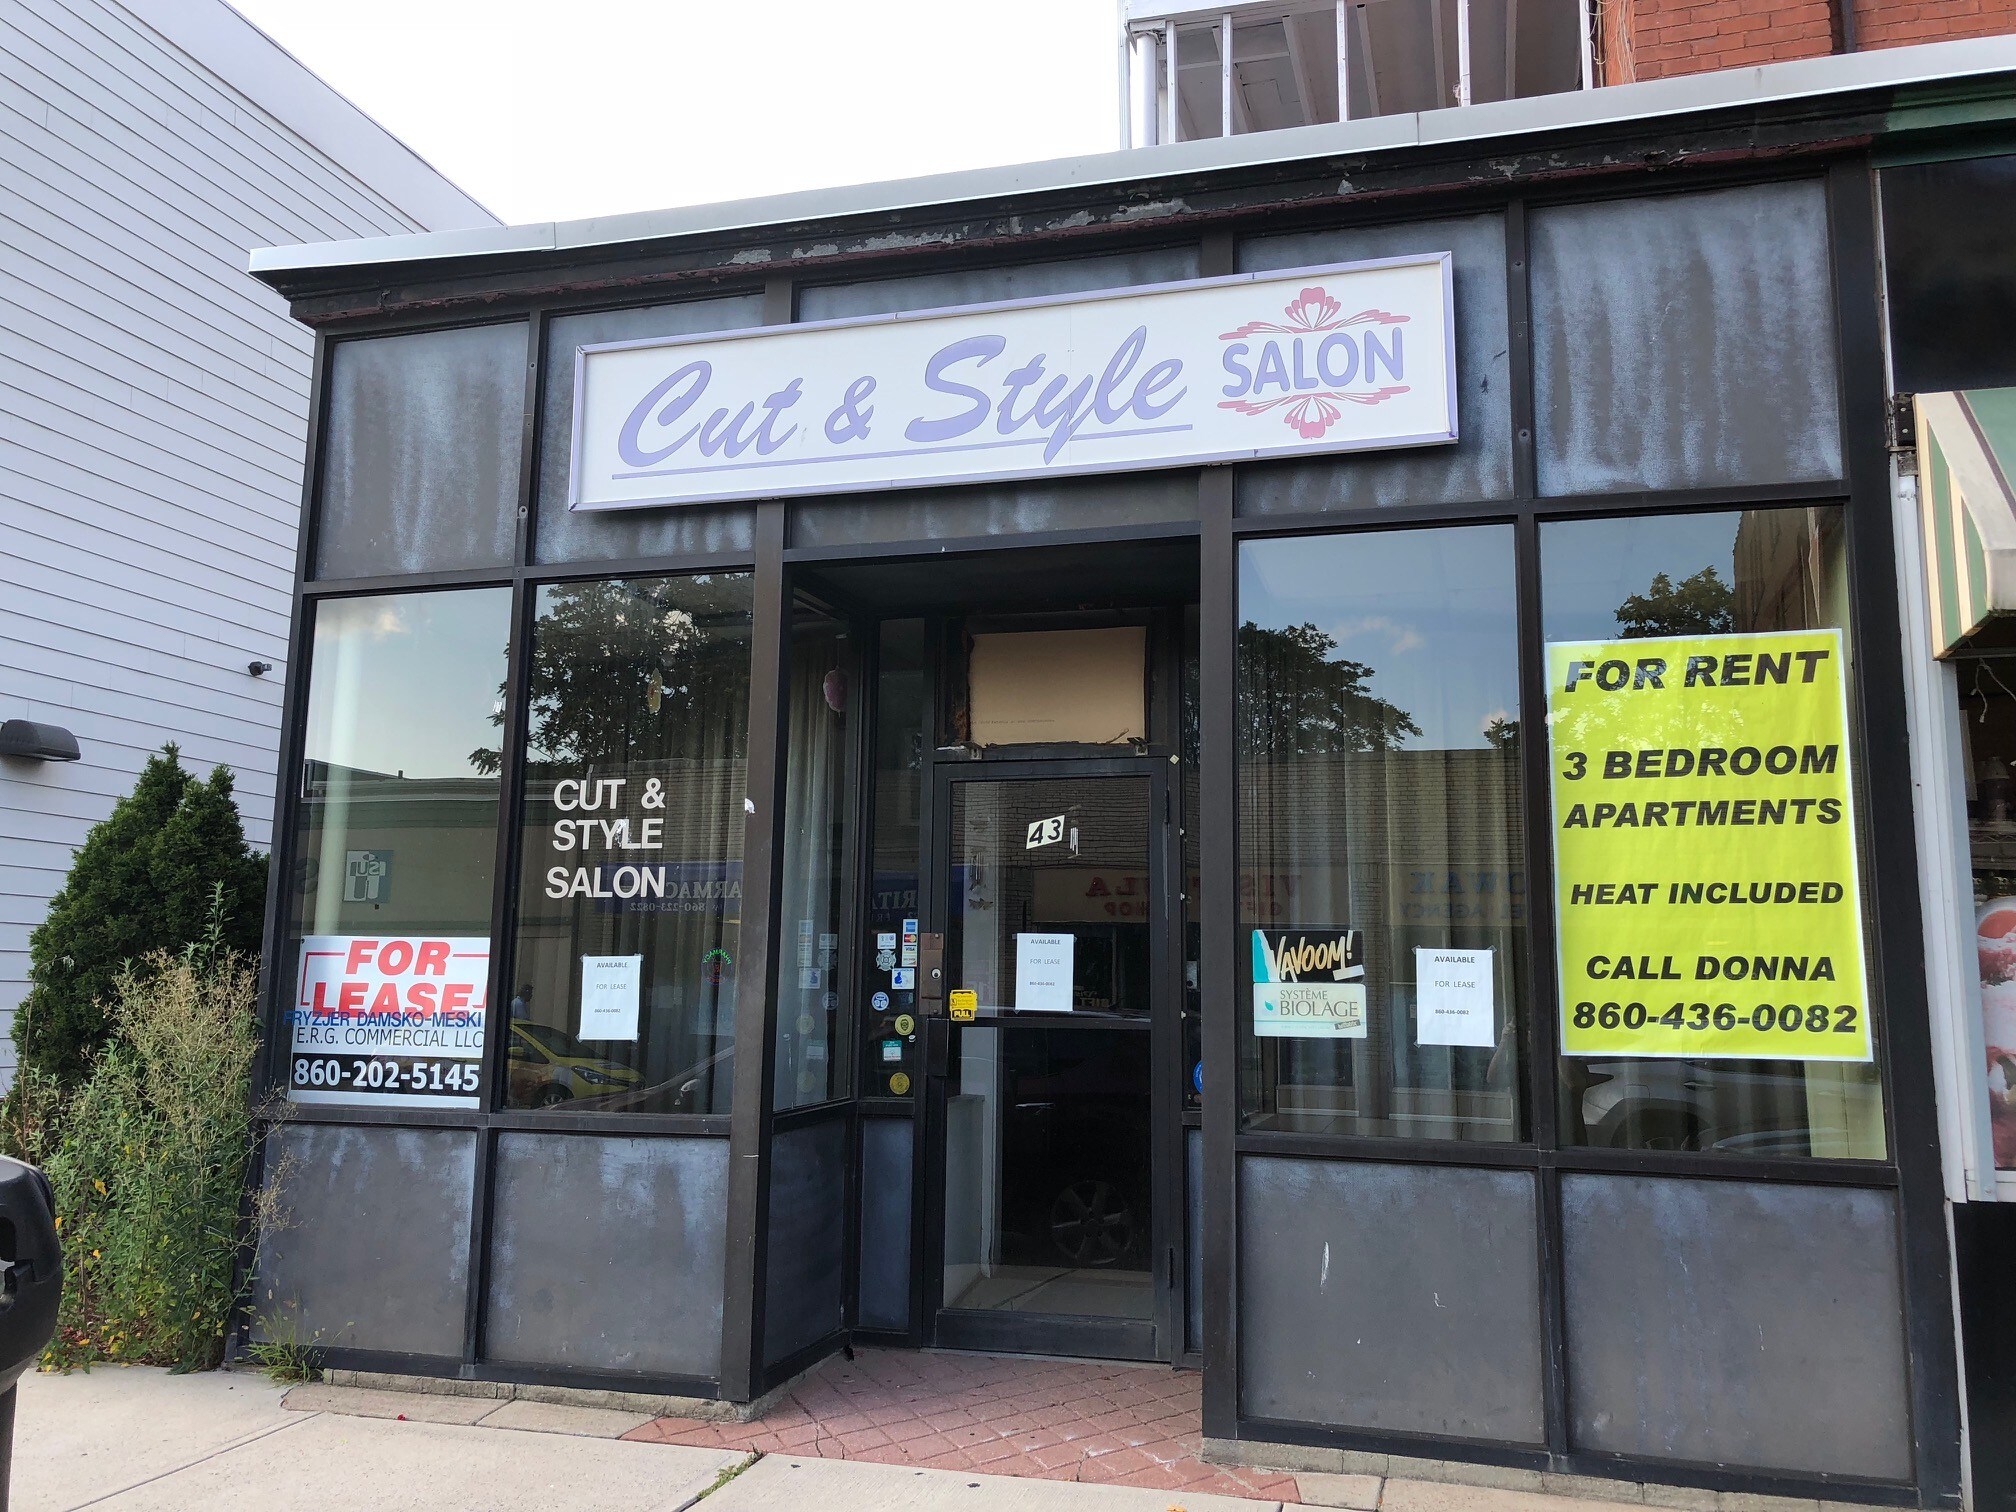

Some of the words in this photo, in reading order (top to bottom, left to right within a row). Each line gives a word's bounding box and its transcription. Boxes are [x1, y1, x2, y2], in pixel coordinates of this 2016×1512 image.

[1222, 327, 1404, 398] SALON
[617, 361, 803, 467] Cut
[825, 376, 877, 444] &
[905, 325, 1188, 466] Style
[1564, 658, 1667, 693] FOR
[1683, 650, 1829, 688] RENT
[1562, 752, 1588, 781] 3
[1602, 745, 1839, 780] BEDROOM
[553, 778, 627, 811] CUT
[641, 777, 666, 809] &
[1563, 797, 1842, 829] APARTMENTS
[552, 818, 664, 851] STYLE
[1029, 818, 1062, 844] 43
[545, 866, 666, 899] SALON
[1570, 883, 1658, 905] HEAT
[1668, 882, 1844, 904] INCLUDED
[345, 940, 451, 976] FOR
[1270, 930, 1354, 983] VAVOOM!
[1434, 956, 1476, 964] AVAILABLE
[1585, 955, 1682, 981] CALL
[1694, 955, 1836, 982] DONNA
[312, 982, 474, 1019] LEASE
[1280, 987, 1328, 1000] SYSTÈME
[1453, 981, 1476, 989] LEASE
[283, 1011, 350, 1027] FRYZJER
[357, 1011, 482, 1028] DAMSKO-MESKI
[954, 1010, 971, 1018] PULL
[1280, 1000, 1359, 1017] BIOLAGE
[1573, 1002, 1857, 1034] 860-436-0082
[296, 1027, 339, 1044] E.R.G.
[345, 1028, 449, 1047] COMMERCIAL
[454, 1030, 484, 1048] LLC
[293, 1058, 481, 1091] 860-202-5145
